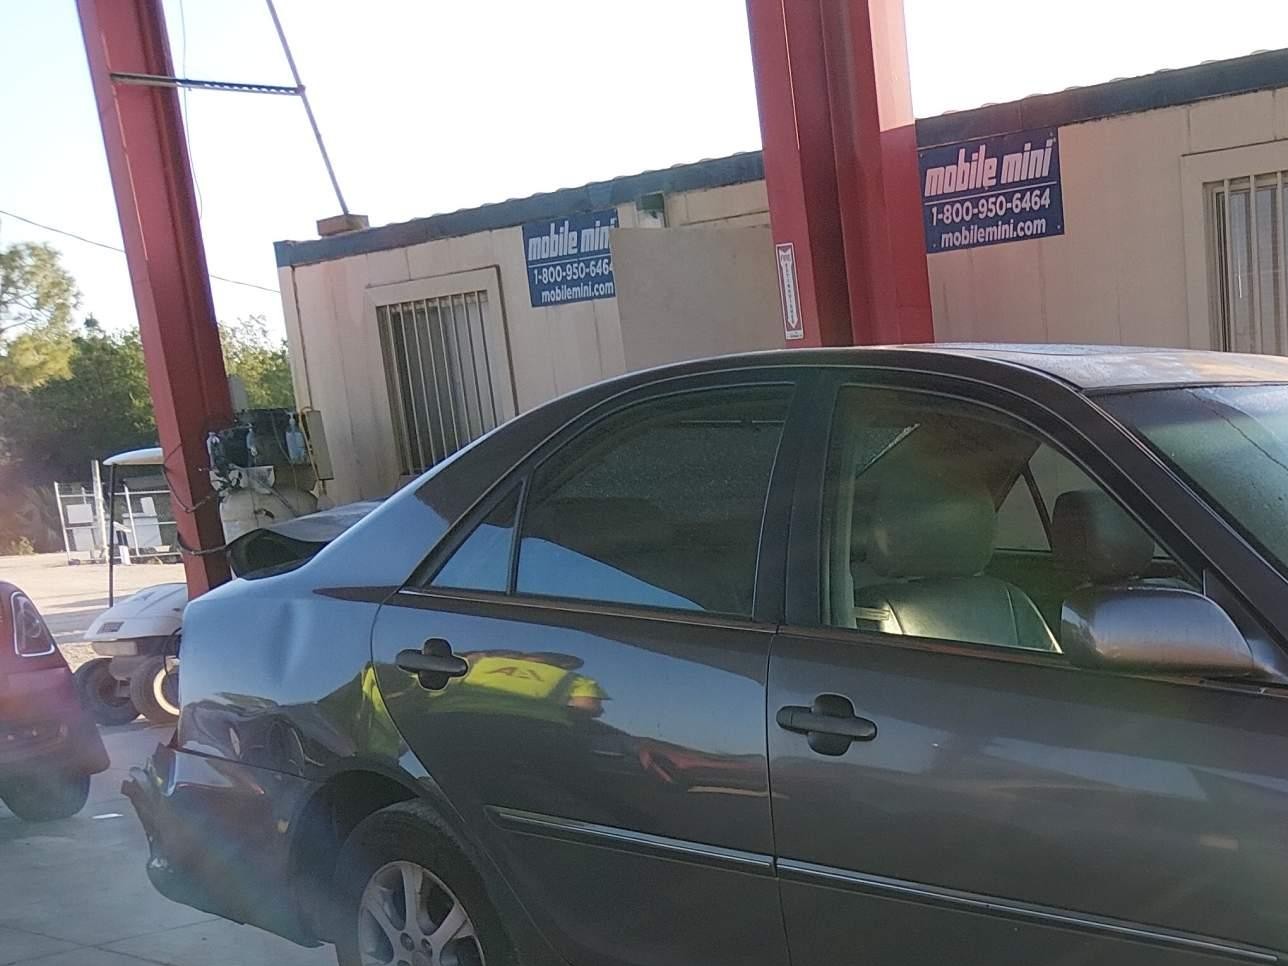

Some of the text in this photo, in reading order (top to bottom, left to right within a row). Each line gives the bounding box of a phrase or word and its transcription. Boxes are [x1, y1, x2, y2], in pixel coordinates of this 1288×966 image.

[924, 139, 1053, 197] mobile mini
[931, 188, 1051, 226] 1-800-950-6464
[527, 220, 578, 261] mobile
[941, 217, 1046, 248] mobilemini.com
[541, 281, 614, 304] mobilemini.com
